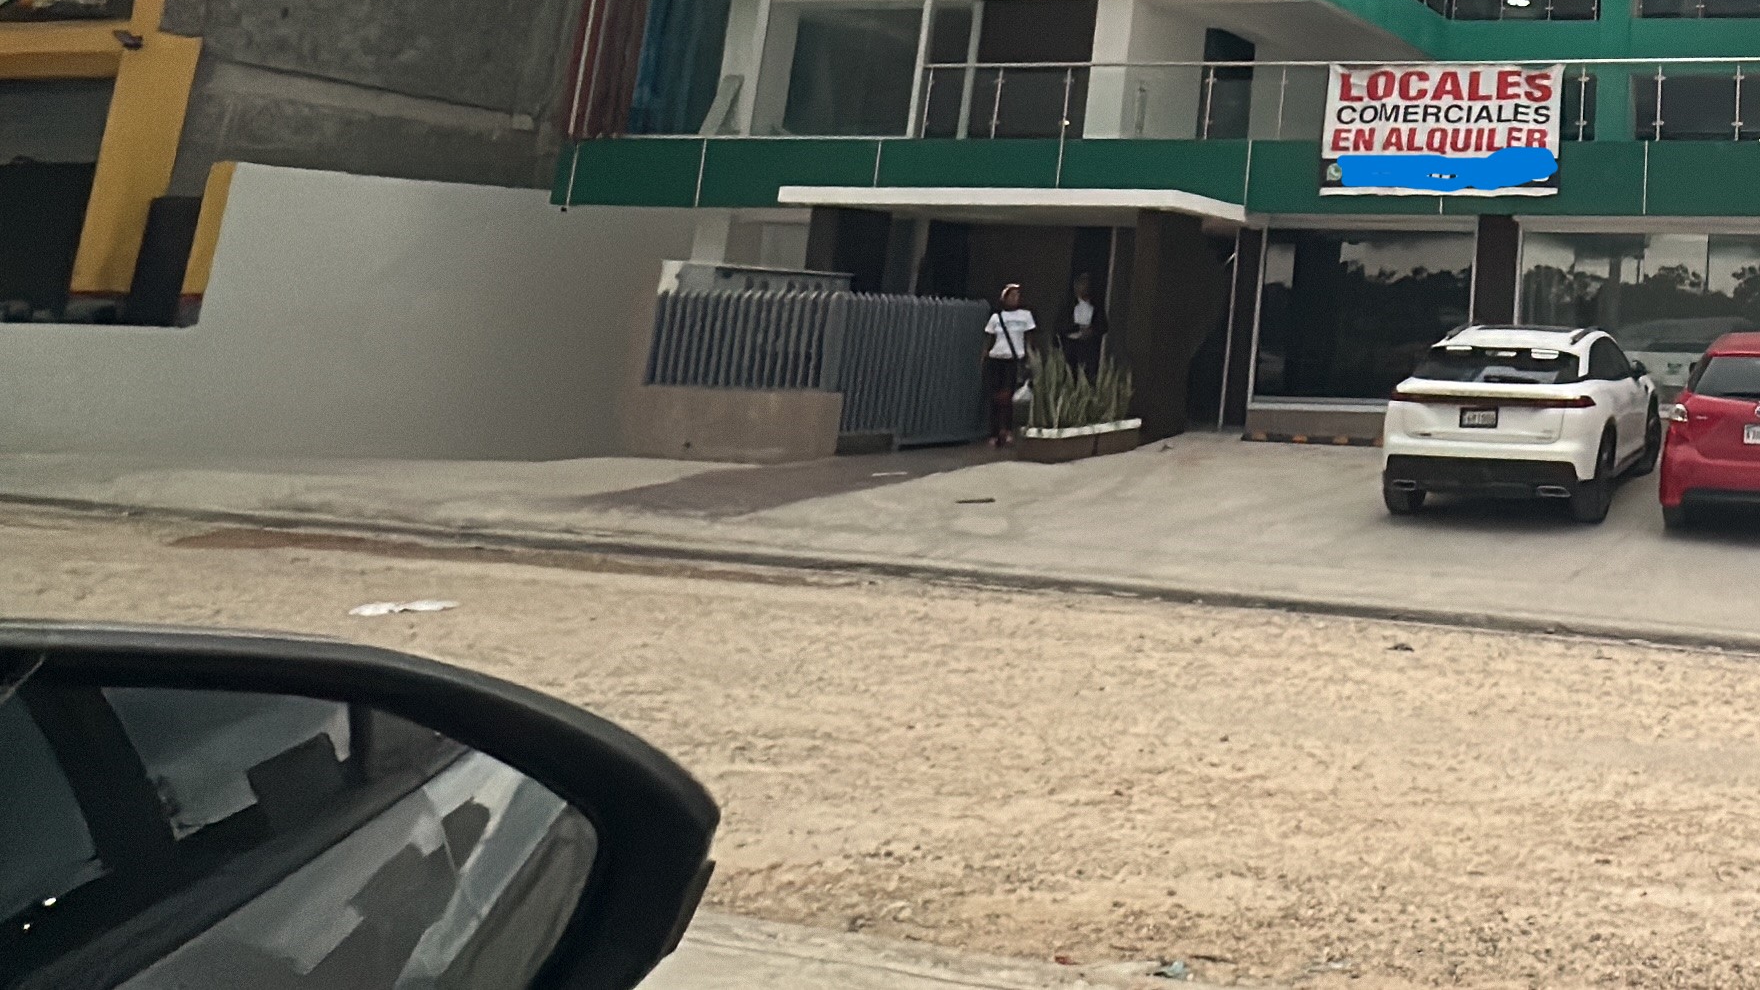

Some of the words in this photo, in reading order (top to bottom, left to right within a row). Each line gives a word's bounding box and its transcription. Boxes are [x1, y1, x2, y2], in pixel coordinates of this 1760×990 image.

[1338, 70, 1553, 103] LOCALES
[1336, 103, 1550, 124] COMERCIALES
[1331, 127, 1376, 151] EN
[1382, 127, 1549, 152] ALQUILER
